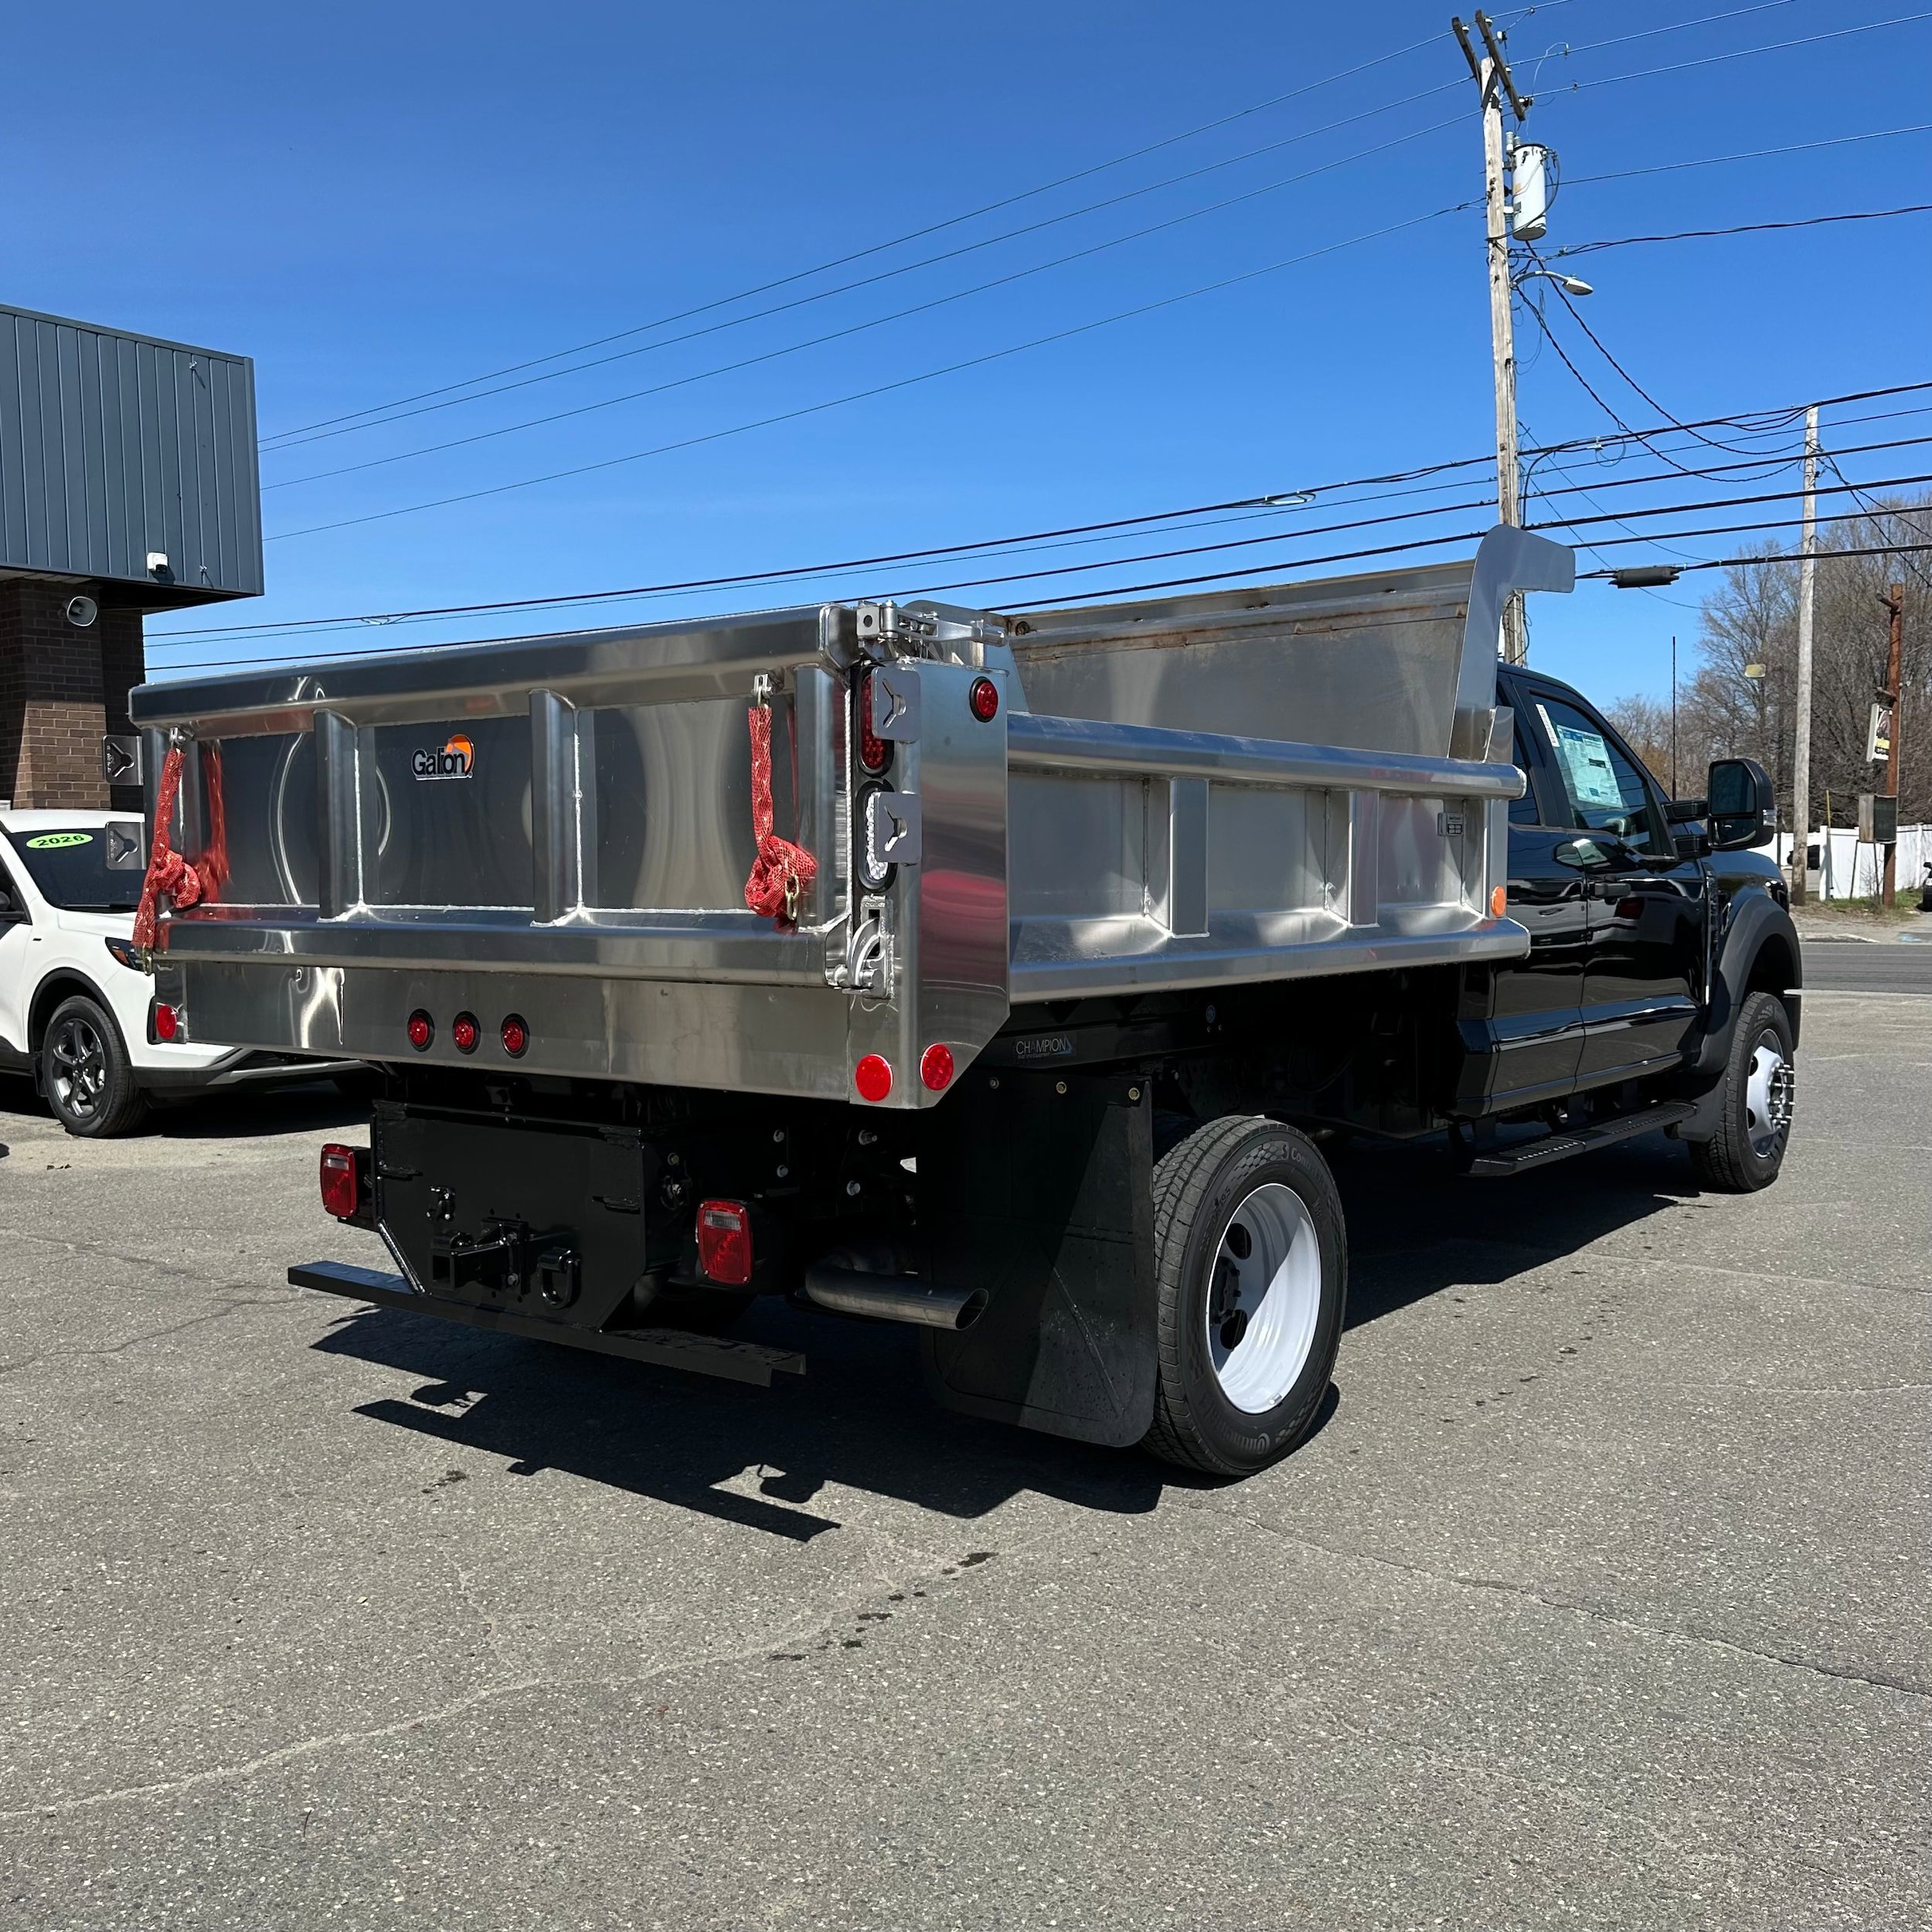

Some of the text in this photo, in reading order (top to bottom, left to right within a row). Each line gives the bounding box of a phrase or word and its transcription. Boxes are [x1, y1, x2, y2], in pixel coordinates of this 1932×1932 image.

[412, 747, 467, 777] Galion
[36, 835, 84, 847] 2026
[1015, 1038, 1066, 1055] CHAMPION
